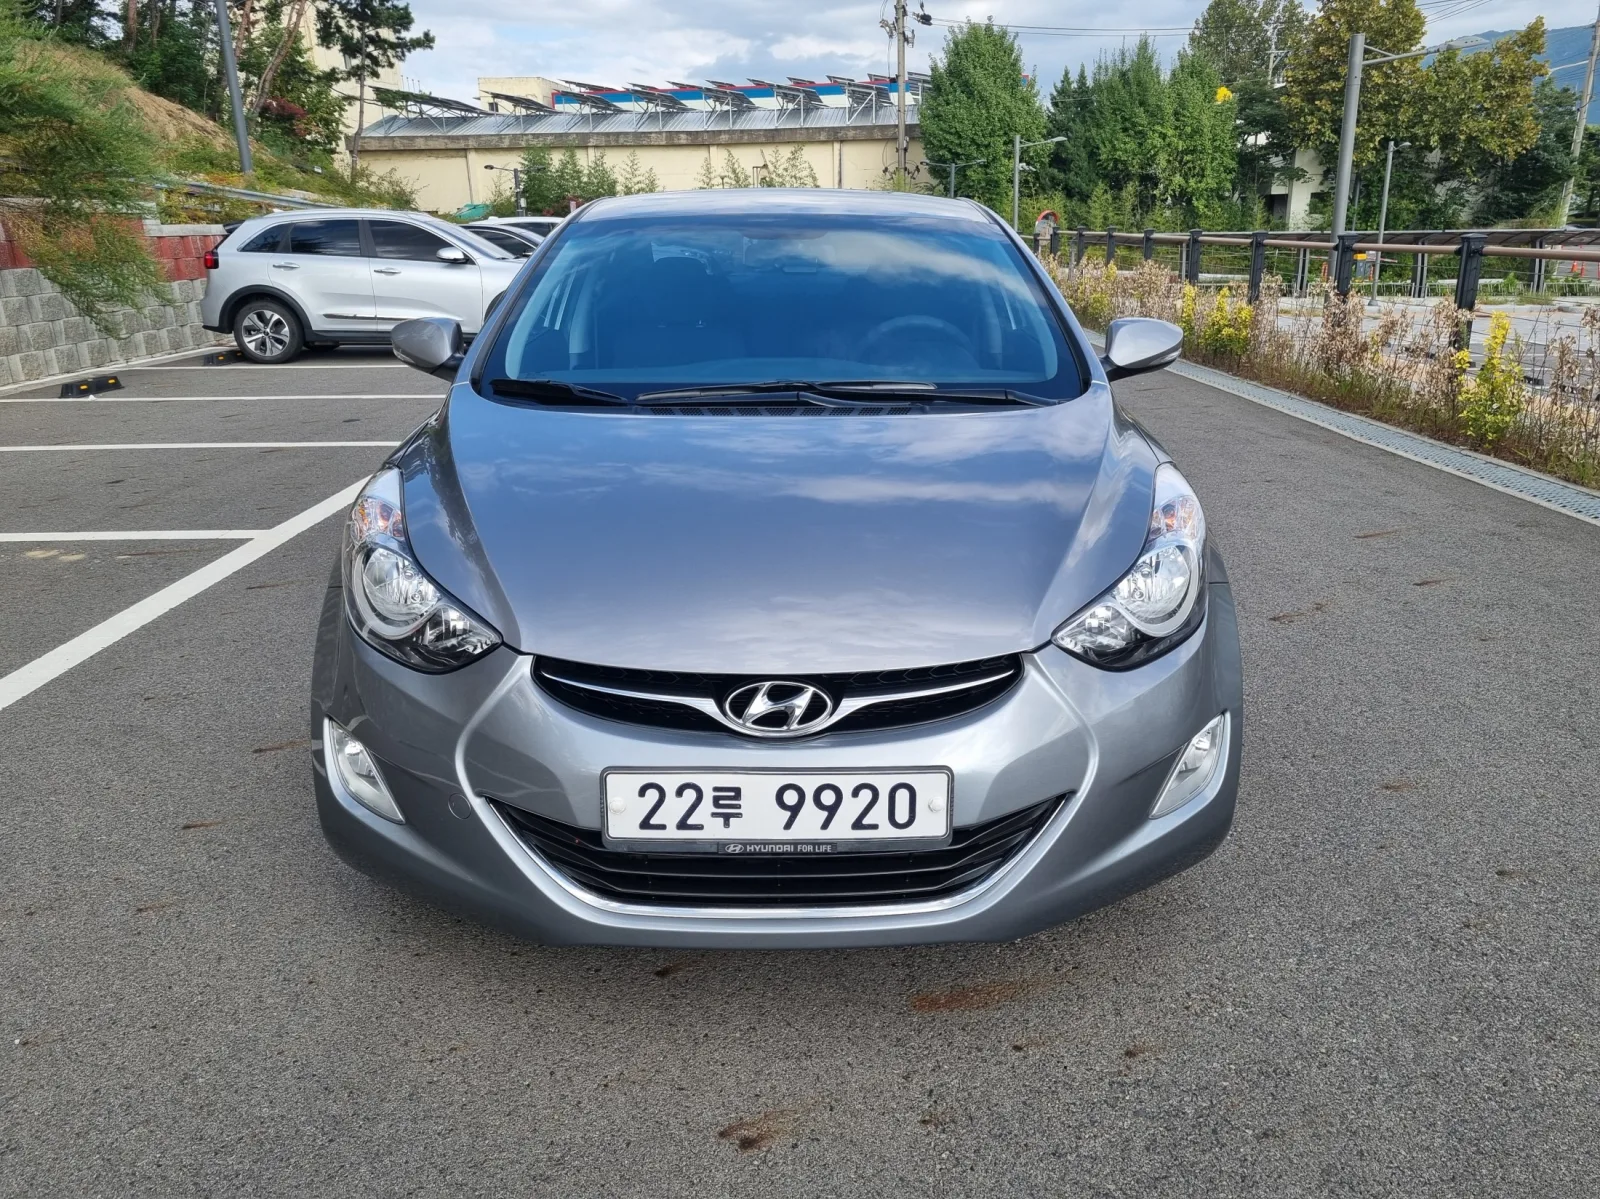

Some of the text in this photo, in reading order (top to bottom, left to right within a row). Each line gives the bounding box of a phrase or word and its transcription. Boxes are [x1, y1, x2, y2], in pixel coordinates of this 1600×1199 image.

[637, 782, 917, 831] 22루 9920
[746, 844, 832, 853] HYUNDAI FOR LIFE
